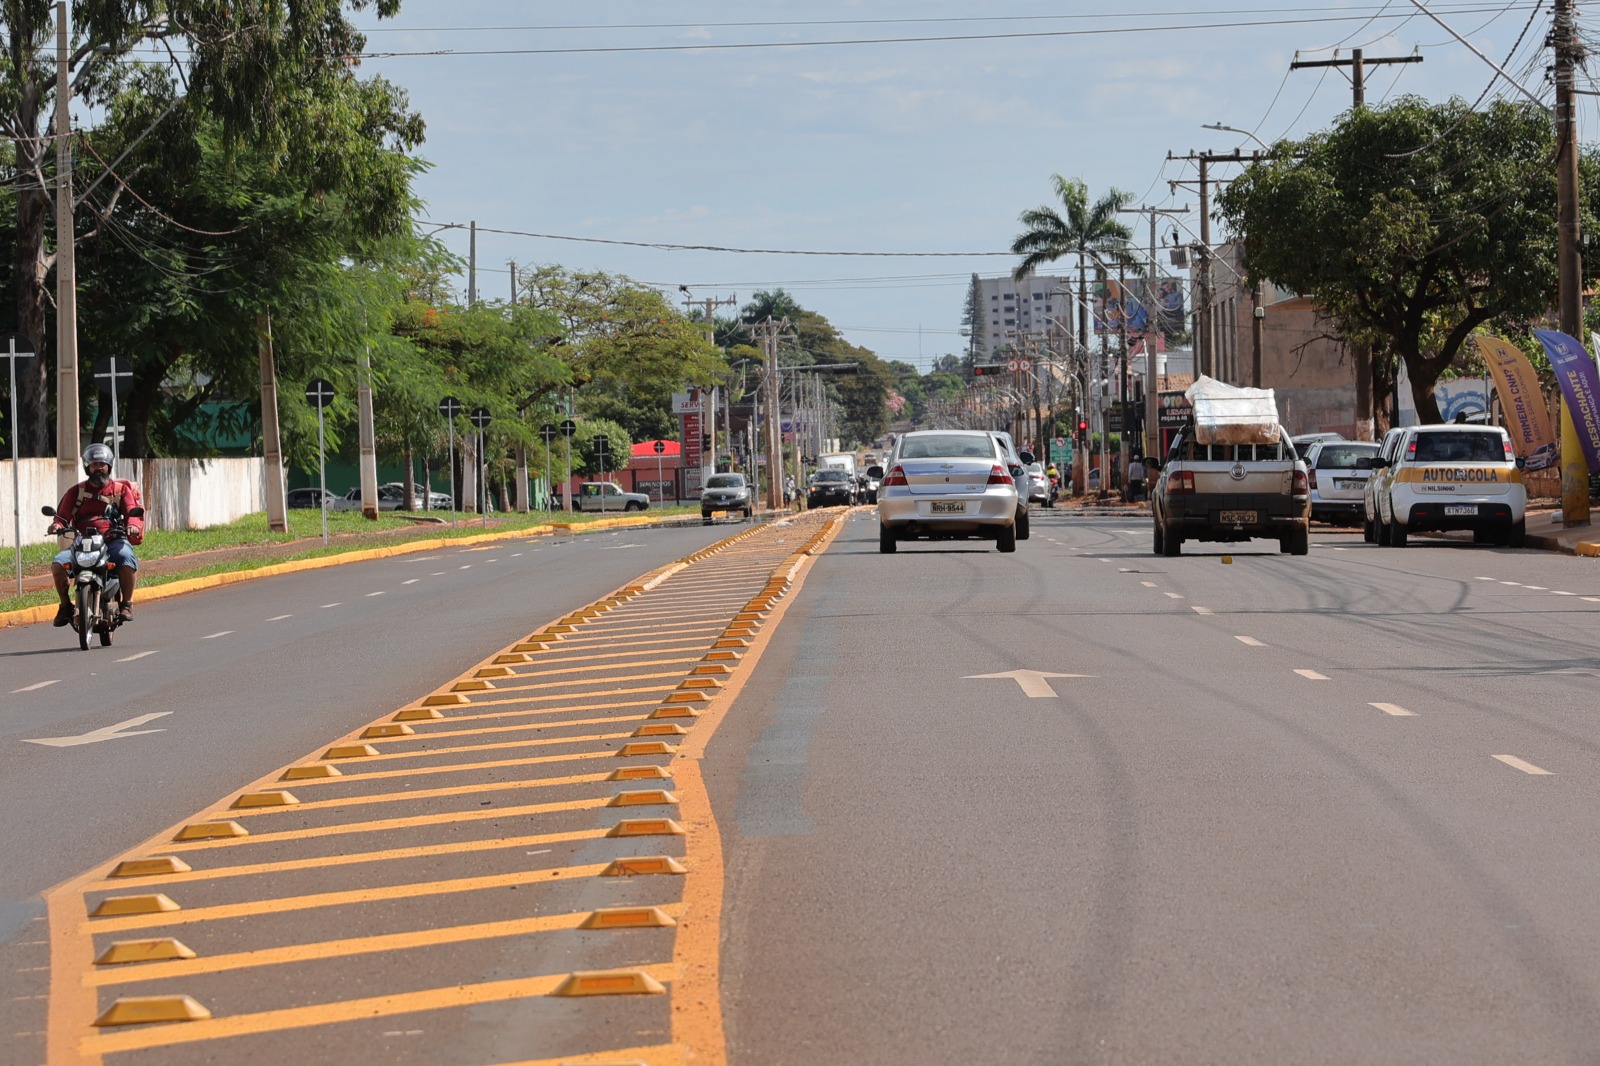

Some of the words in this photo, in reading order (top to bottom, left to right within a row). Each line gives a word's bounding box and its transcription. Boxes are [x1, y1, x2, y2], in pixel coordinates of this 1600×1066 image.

[1504, 369, 1520, 394] CNH?
[1514, 396, 1534, 444] PRIMEIRA
[1567, 370, 1600, 448] DESPACHANTE
[1423, 468, 1498, 481] AUTOESCOLA
